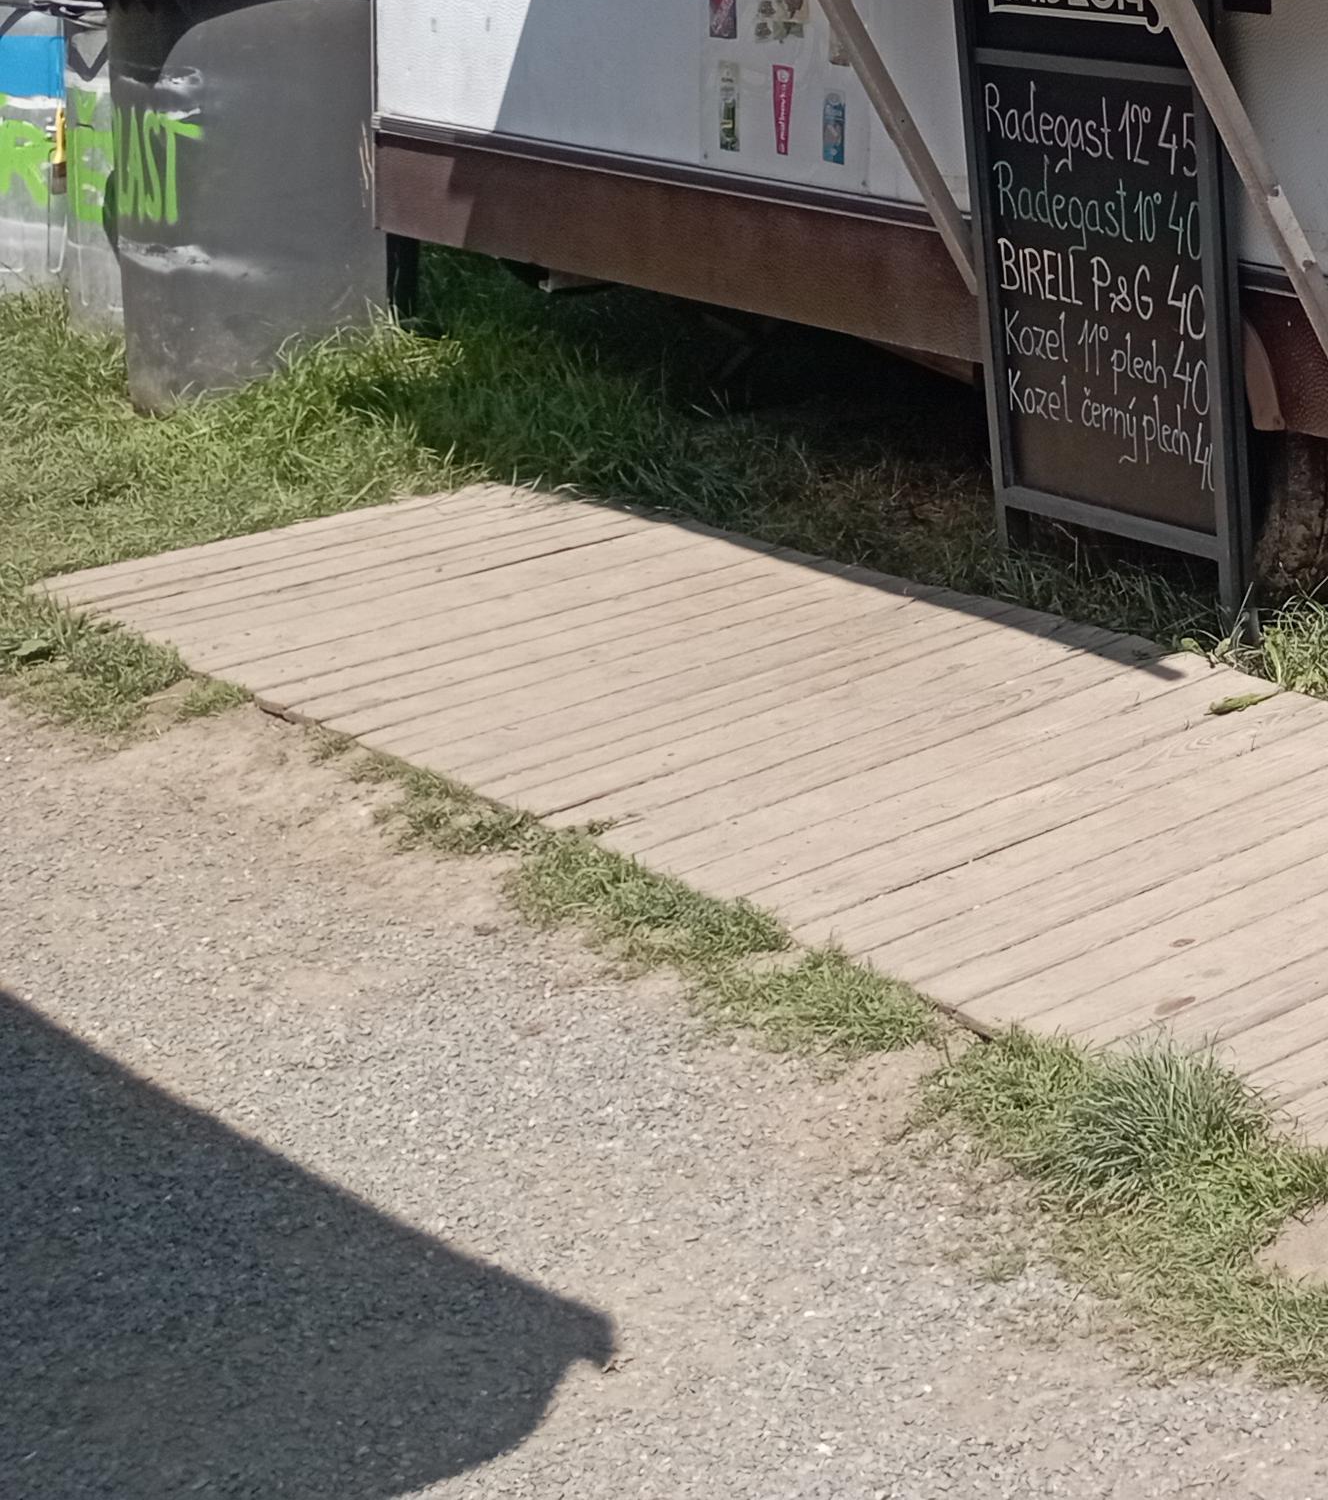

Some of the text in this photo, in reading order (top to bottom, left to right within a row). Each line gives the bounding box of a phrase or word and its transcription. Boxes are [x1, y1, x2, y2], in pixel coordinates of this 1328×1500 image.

[985, 80, 1114, 173] Radegast
[1158, 105, 1198, 177] 45
[993, 154, 1133, 257] Radegast
[1168, 190, 1201, 260] 40
[998, 238, 1083, 306] BIRELL
[1167, 264, 1206, 340] 40
[1004, 308, 1069, 363] Kozel
[1111, 332, 1168, 396] plech
[1172, 340, 1210, 416] 40
[1008, 368, 1073, 424] Kozel
[1081, 386, 1138, 464] černý
[1142, 394, 1192, 464] plech
